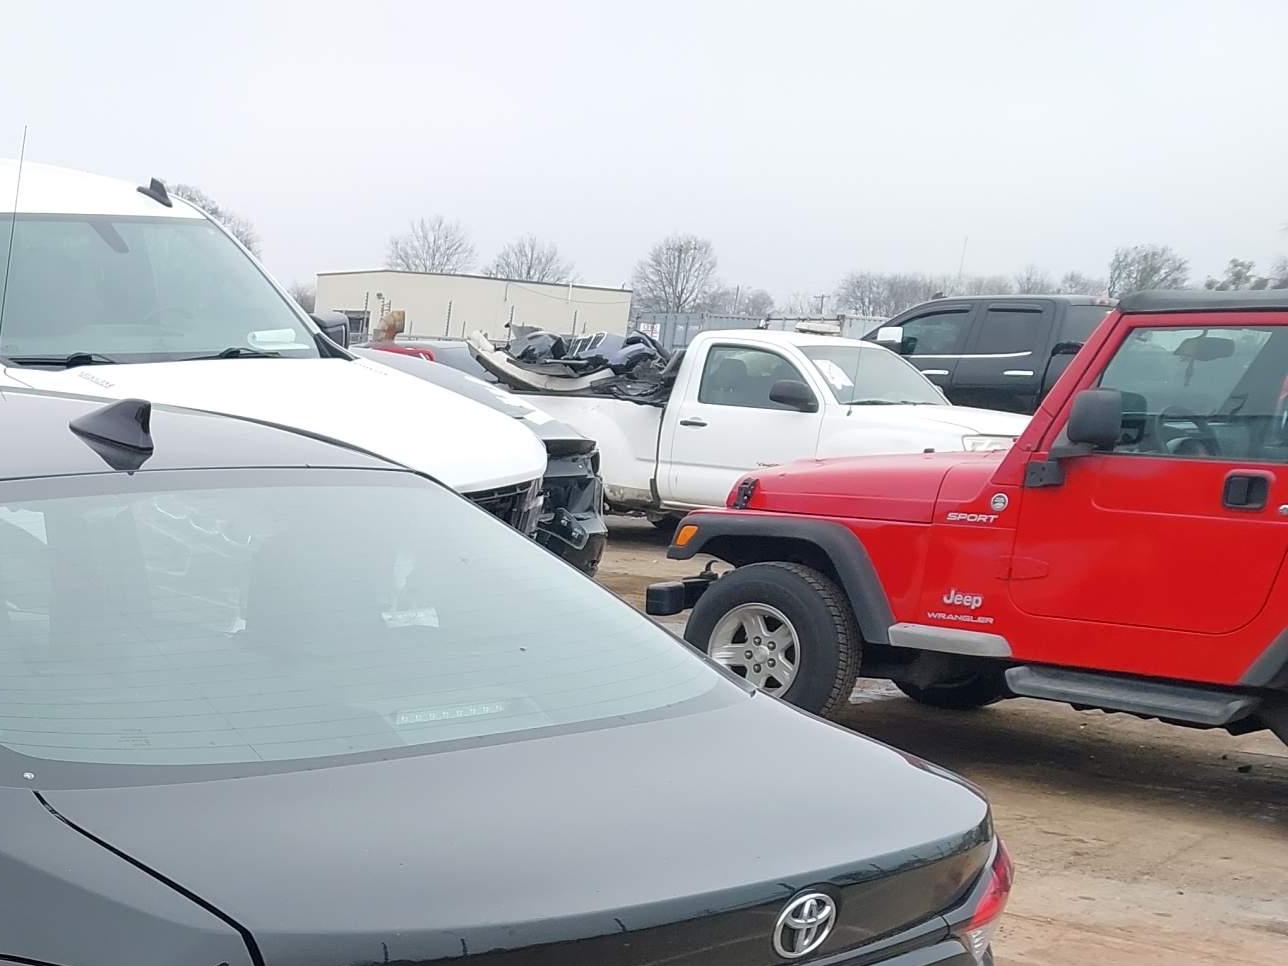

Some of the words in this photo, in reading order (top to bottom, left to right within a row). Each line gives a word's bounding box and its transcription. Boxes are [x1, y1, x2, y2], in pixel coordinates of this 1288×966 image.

[946, 512, 1000, 524] SPORT
[943, 587, 983, 609] Jeep
[926, 611, 995, 625] WRANGLER
